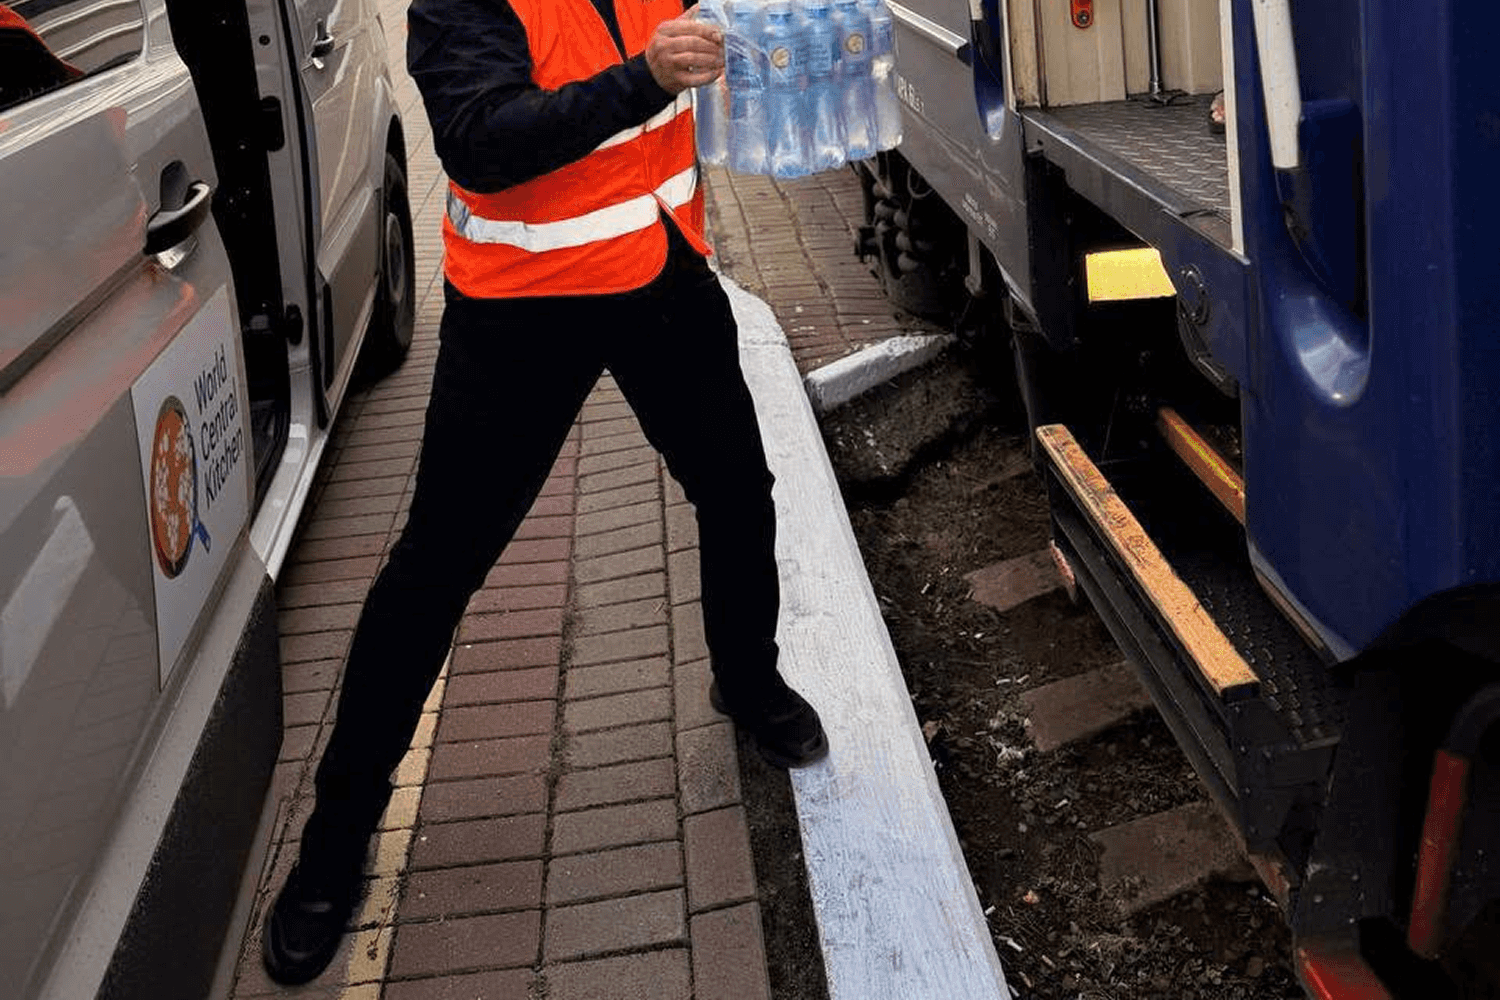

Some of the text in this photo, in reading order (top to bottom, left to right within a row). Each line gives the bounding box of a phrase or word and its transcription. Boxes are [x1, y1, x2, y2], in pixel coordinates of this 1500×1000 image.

[194, 343, 228, 416] World
[201, 376, 239, 461] Central
[204, 427, 243, 510] Kitchen
